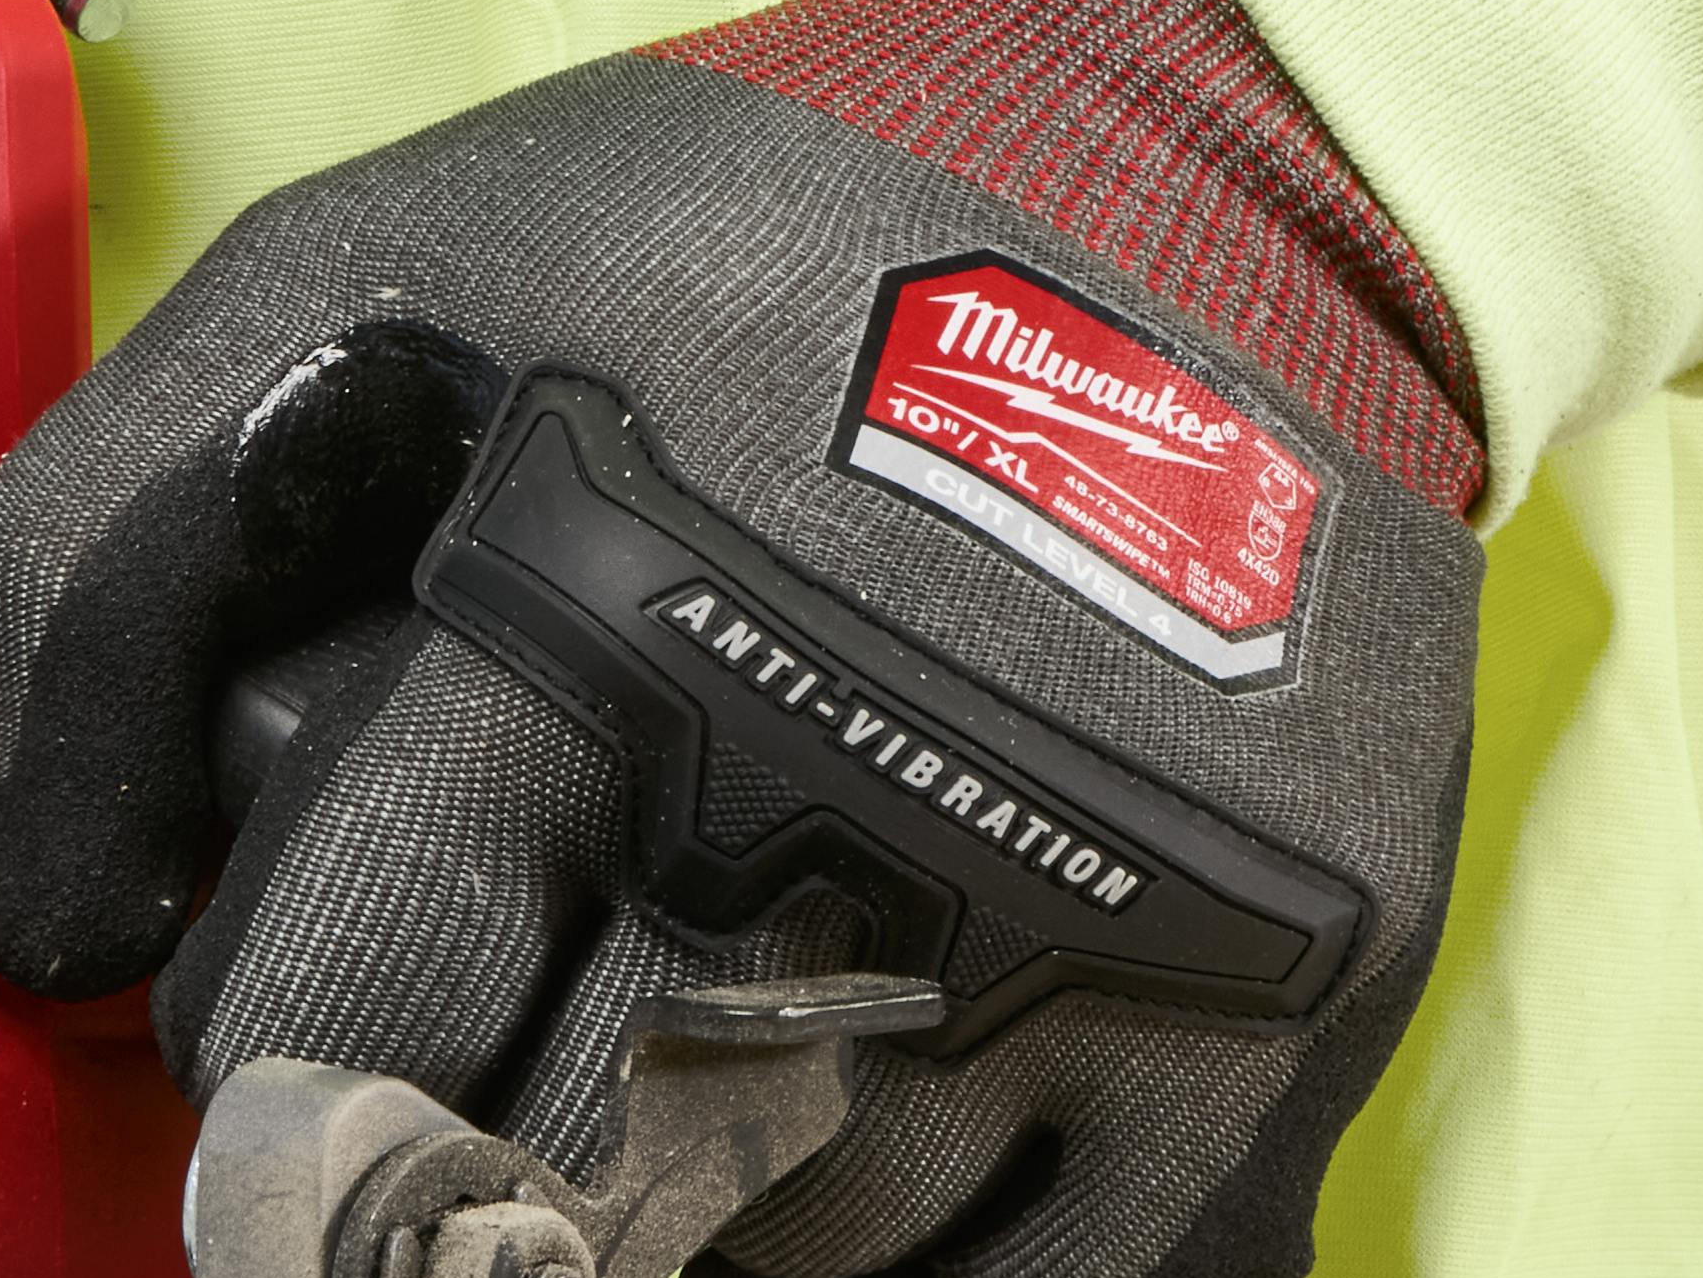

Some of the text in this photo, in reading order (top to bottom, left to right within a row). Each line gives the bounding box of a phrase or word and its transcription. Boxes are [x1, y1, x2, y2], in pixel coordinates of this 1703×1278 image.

[984, 440, 1039, 495] XL
[1064, 475, 1169, 553] 48-73-8763
[925, 468, 1173, 637] CUT LEVEL 4
[1187, 557, 1252, 610] ISO 10819
[1237, 547, 1280, 587] 4X42D
[672, 593, 1139, 907] ANTI-VIBRATION
